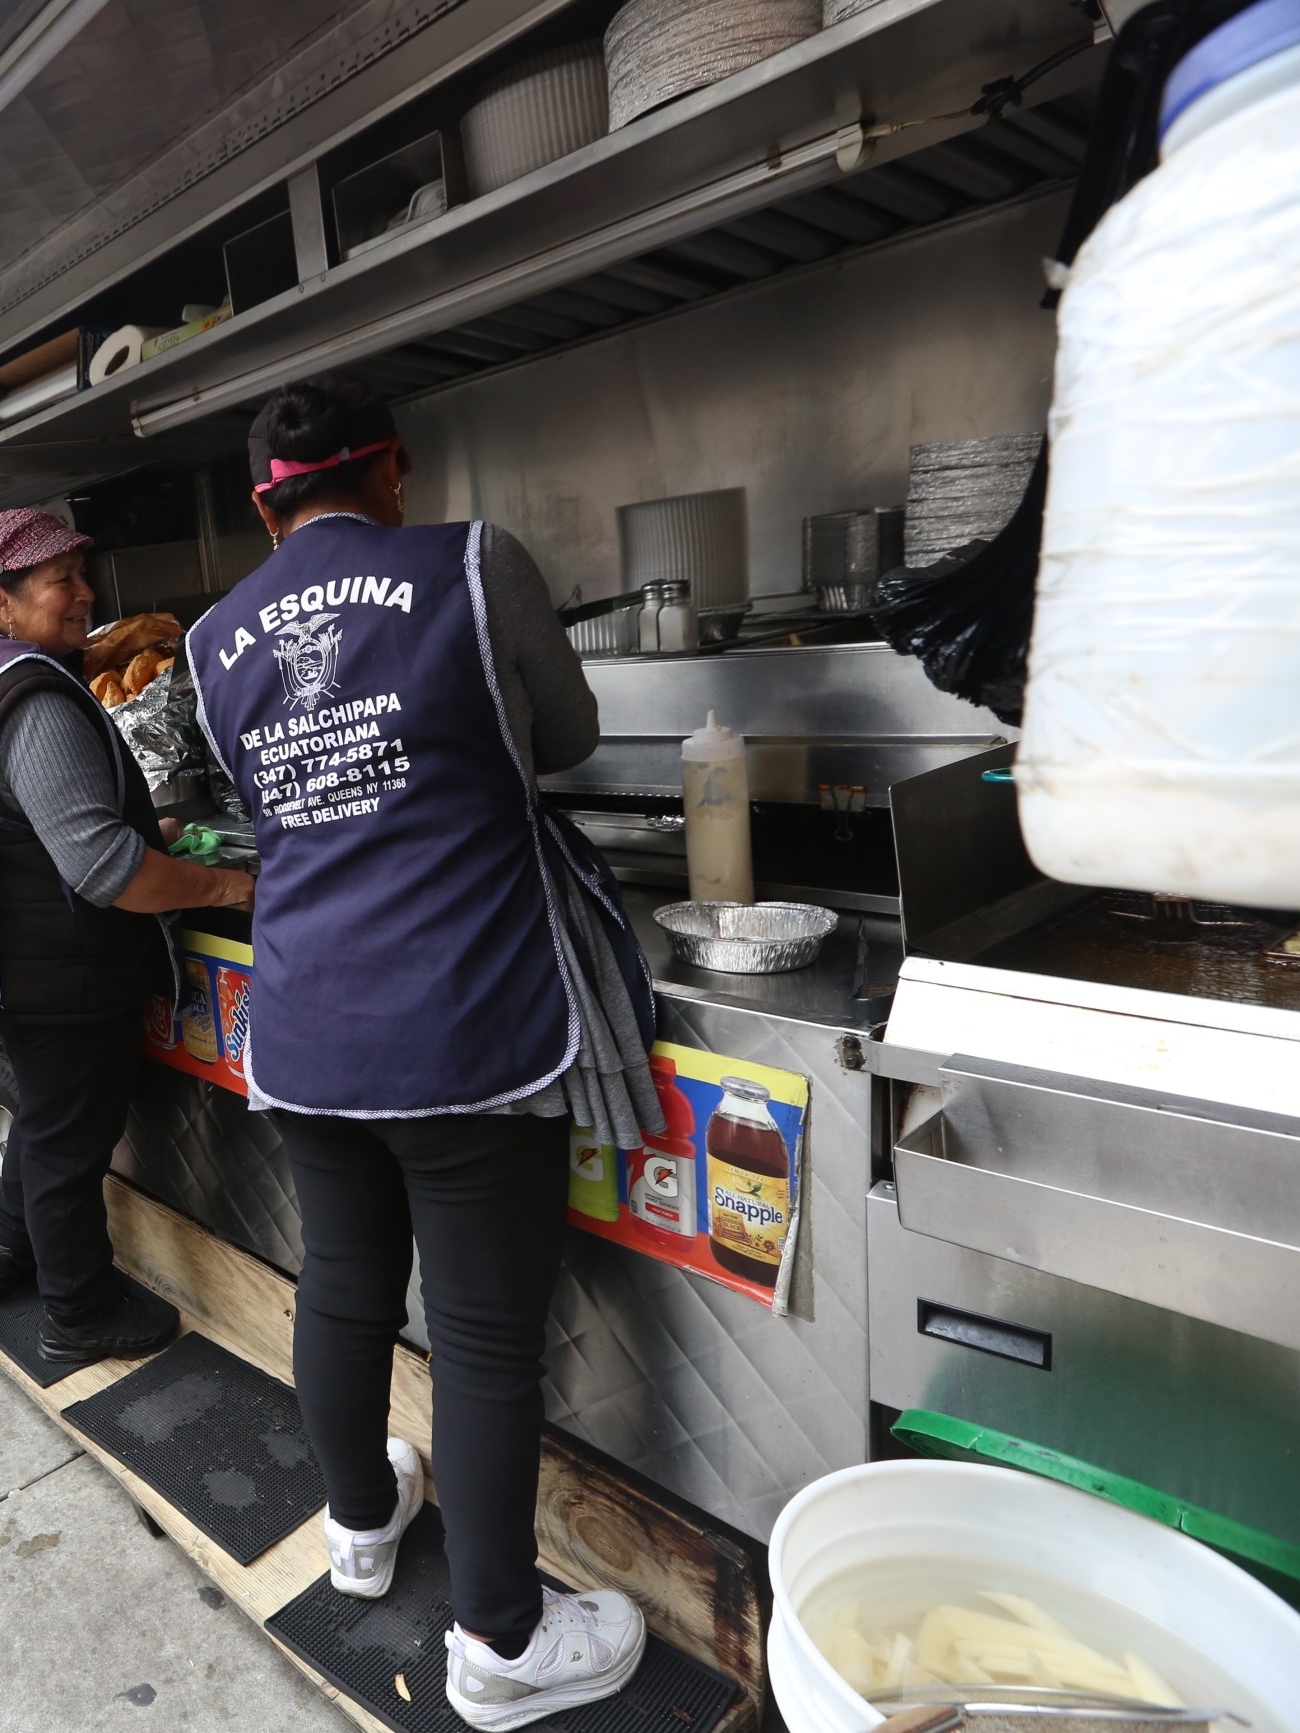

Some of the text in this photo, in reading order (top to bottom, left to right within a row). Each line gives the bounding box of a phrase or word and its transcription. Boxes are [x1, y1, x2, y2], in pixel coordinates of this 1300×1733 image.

[218, 576, 414, 671] LA ESQUINA
[240, 692, 402, 751] DE LA SALCHIPAPA
[253, 738, 404, 789] (347) 774-5871
[260, 721, 381, 766] ECUATORIANA
[306, 756, 411, 793] 608-8115
[307, 795, 325, 808] AVE.
[327, 786, 364, 802] QUEENS
[366, 782, 379, 795] NY
[382, 777, 407, 792] 11368
[280, 797, 381, 830] FREE DELIVERY
[644, 1157, 679, 1198] G
[727, 1167, 749, 1177] LEMON
[715, 1186, 783, 1226] Snapple
